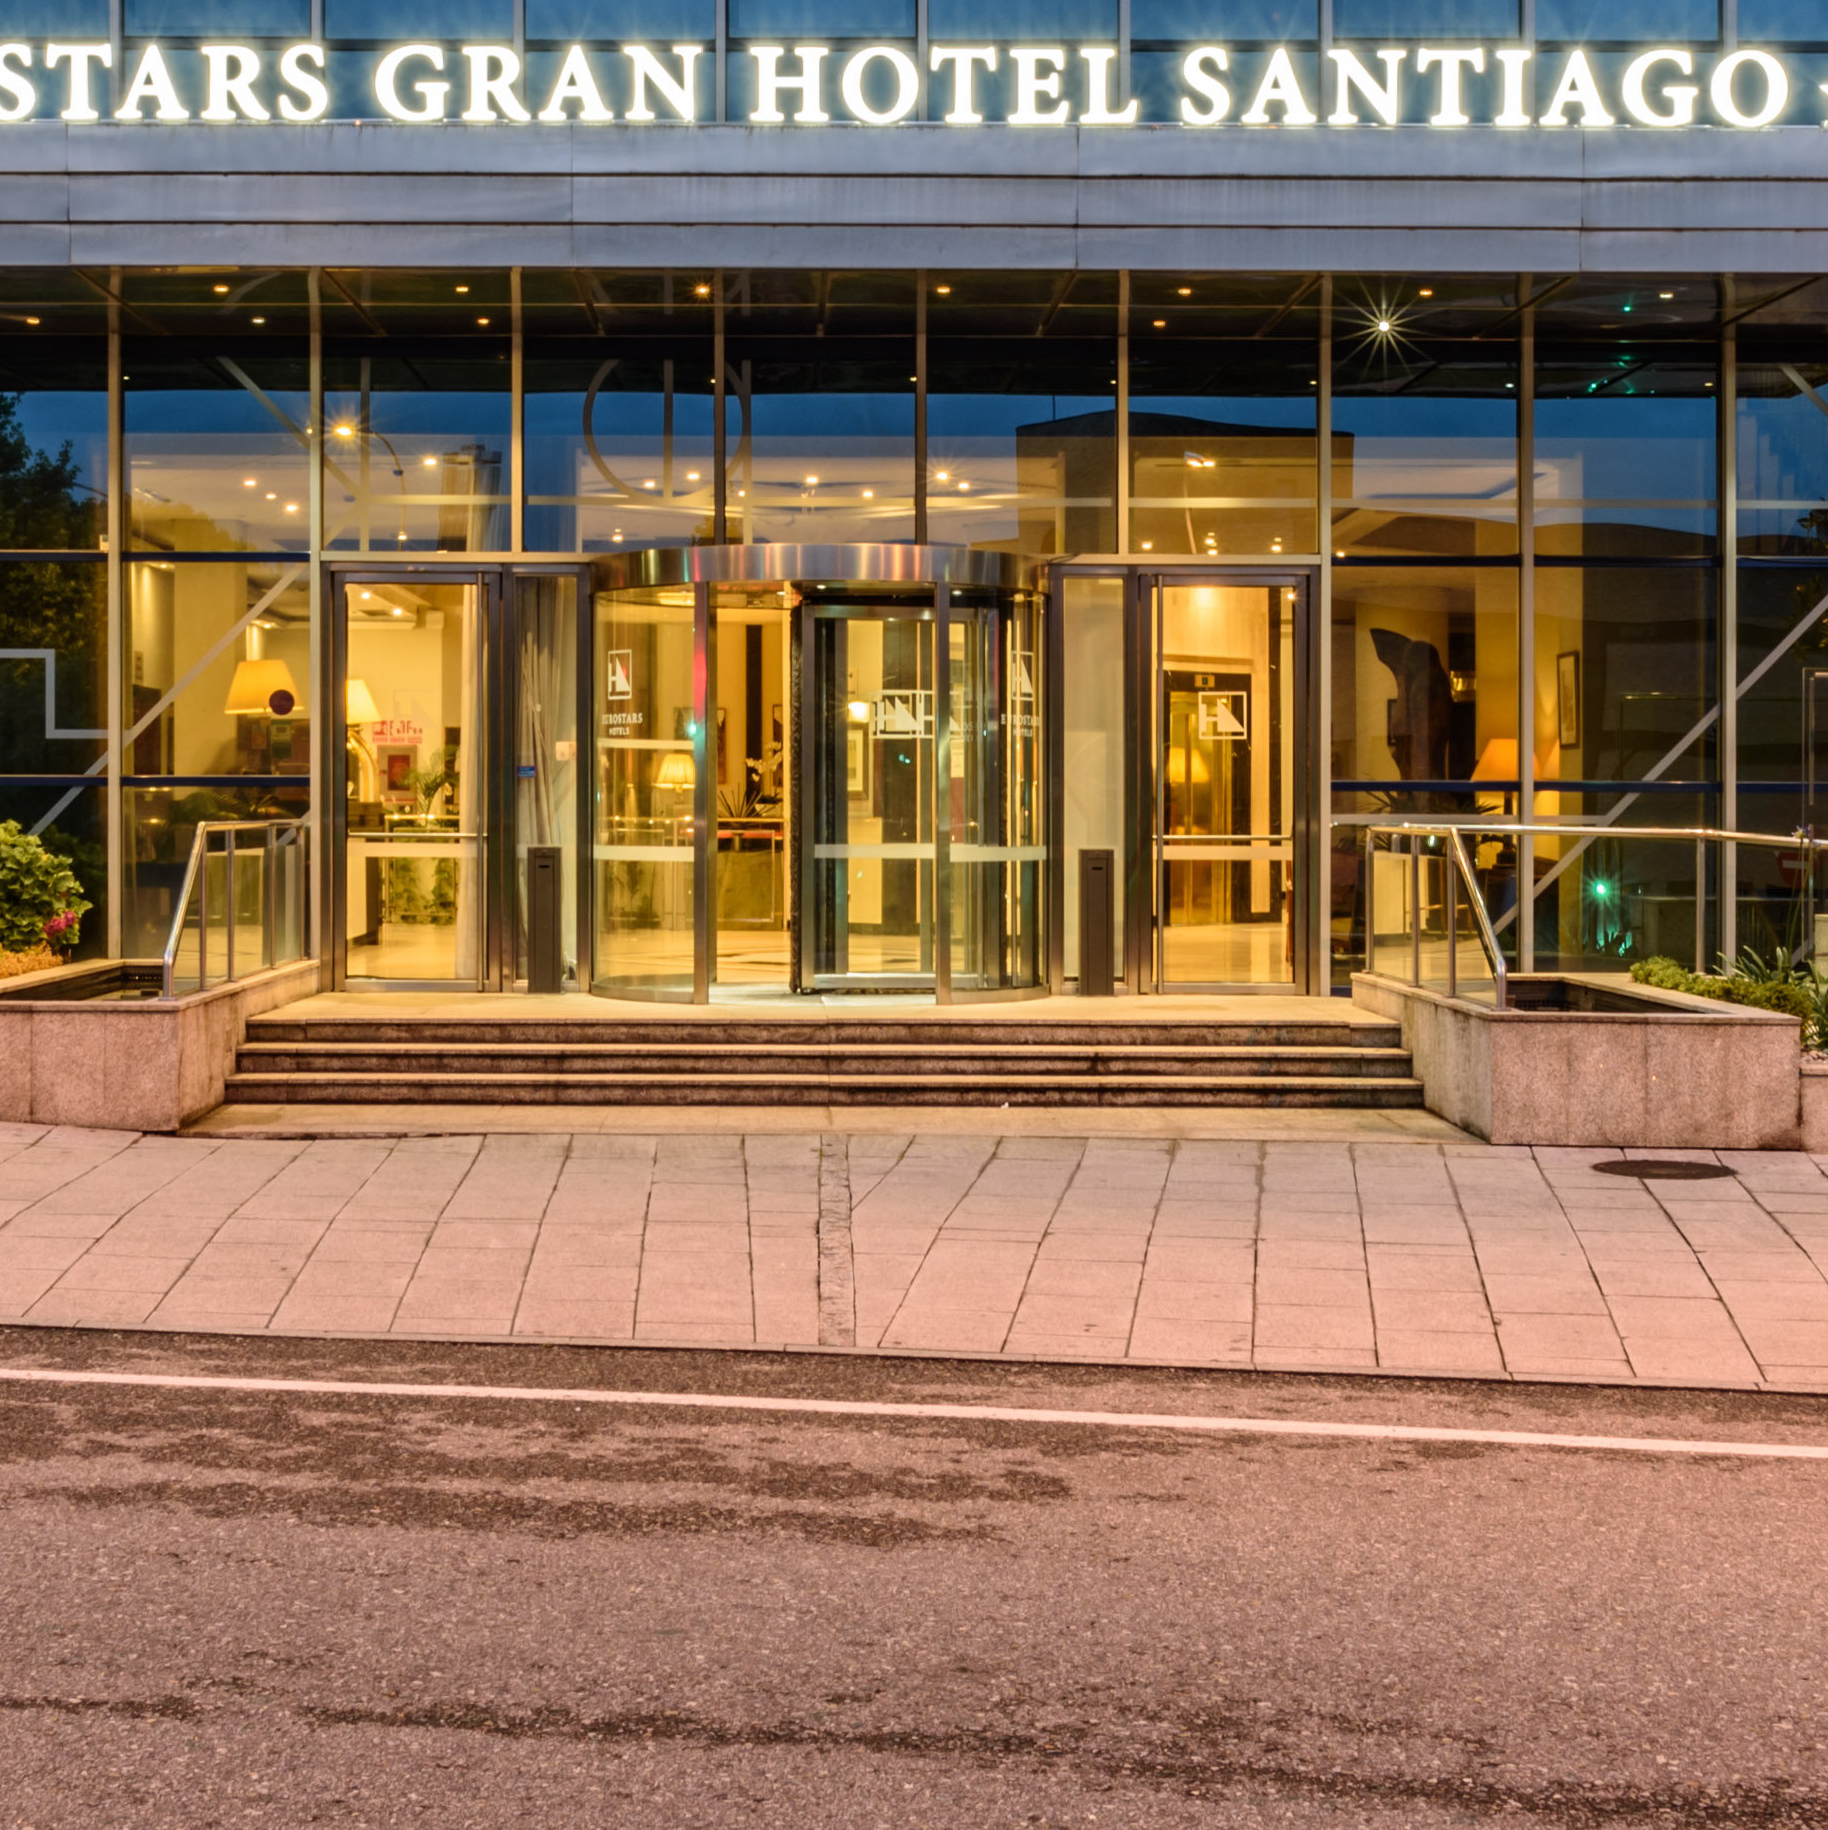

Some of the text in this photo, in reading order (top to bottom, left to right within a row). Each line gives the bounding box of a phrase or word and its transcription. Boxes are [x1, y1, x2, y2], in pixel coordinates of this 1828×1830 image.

[374, 44, 702, 121] GRAN
[749, 46, 1138, 121] HOTEL
[1180, 46, 1789, 121] SANTIAGO
